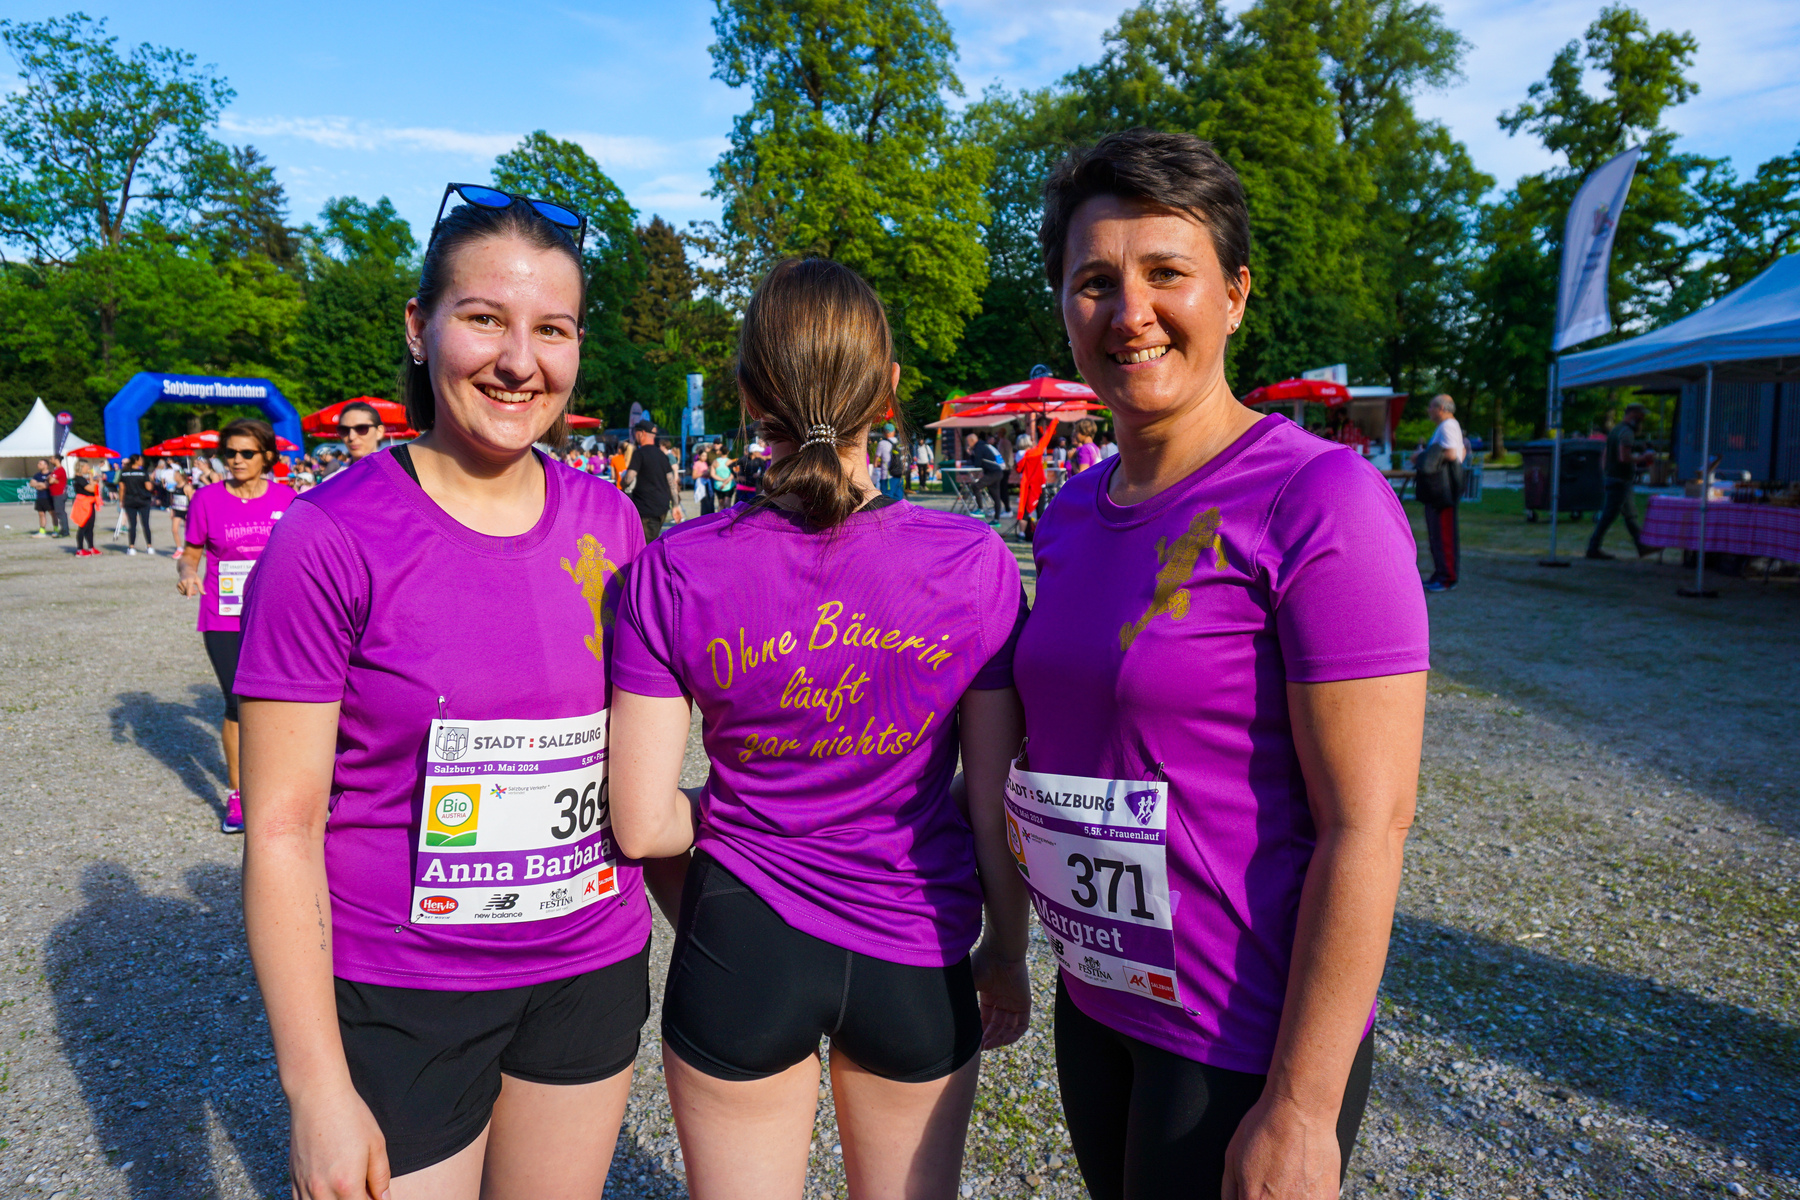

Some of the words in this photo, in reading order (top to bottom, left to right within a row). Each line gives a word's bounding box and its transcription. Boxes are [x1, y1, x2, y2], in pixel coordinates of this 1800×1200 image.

[163, 379, 214, 399] Salzburger
[214, 382, 268, 398] Nachrichten
[706, 627, 798, 689] Ohne
[808, 600, 953, 671] Bäuerin
[780, 663, 871, 722] läuft
[474, 735, 525, 749] STADT
[538, 727, 601, 749] SALZBURG
[738, 733, 802, 763] gar
[809, 711, 935, 758] nichts!
[434, 764, 475, 775] Salzburg
[483, 763, 496, 772] 10.
[498, 763, 516, 772] Mai
[518, 763, 539, 772] 2024
[442, 799, 467, 813] Bio
[551, 776, 609, 840] 369
[1036, 790, 1115, 812] SALZBURG
[1084, 826, 1102, 837] 5,5K
[1109, 829, 1160, 841] Frauenlauf
[421, 858, 514, 882] Anna
[524, 837, 611, 880] Barbara
[583, 880, 596, 895] AK
[1067, 853, 1155, 920] 371
[423, 899, 456, 911] Hervis
[540, 896, 573, 910] FESTINA
[492, 911, 523, 919] balance
[1033, 891, 1124, 953] Margret
[1078, 962, 1114, 981] FESTINA
[1129, 974, 1148, 989] AK
[1150, 981, 1174, 993] SALZBURG
